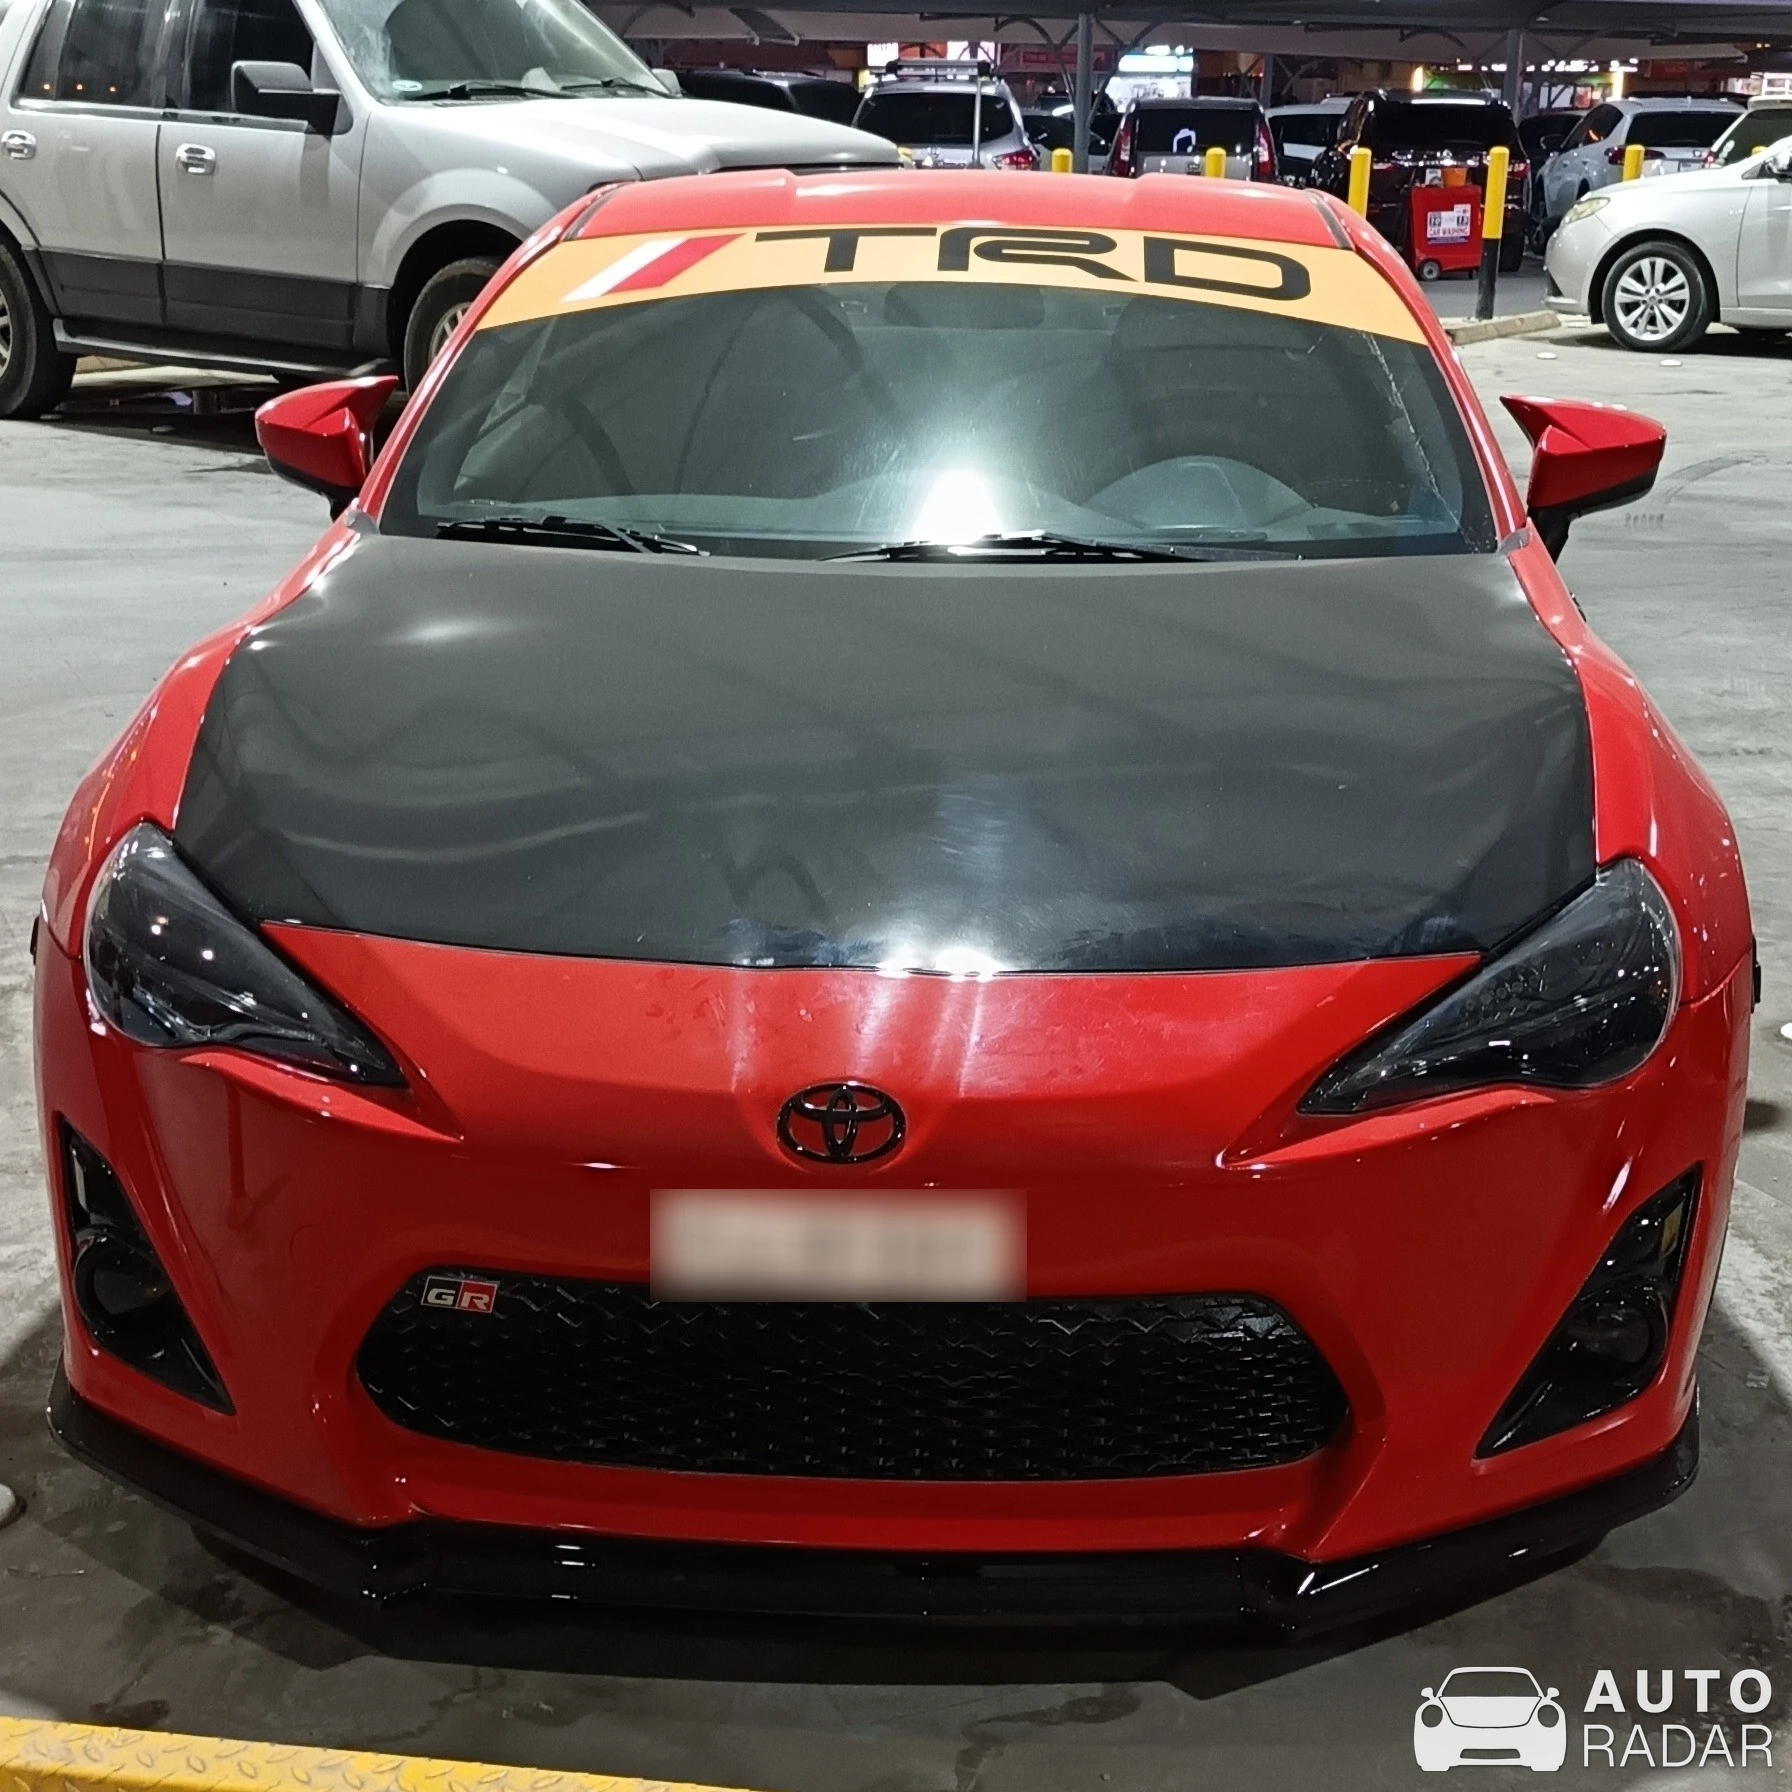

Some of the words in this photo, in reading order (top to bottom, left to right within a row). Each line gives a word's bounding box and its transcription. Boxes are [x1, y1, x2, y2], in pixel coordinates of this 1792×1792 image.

[1429, 228, 1441, 236] CAR
[755, 227, 1312, 300] TRD
[427, 1287, 490, 1310] GR
